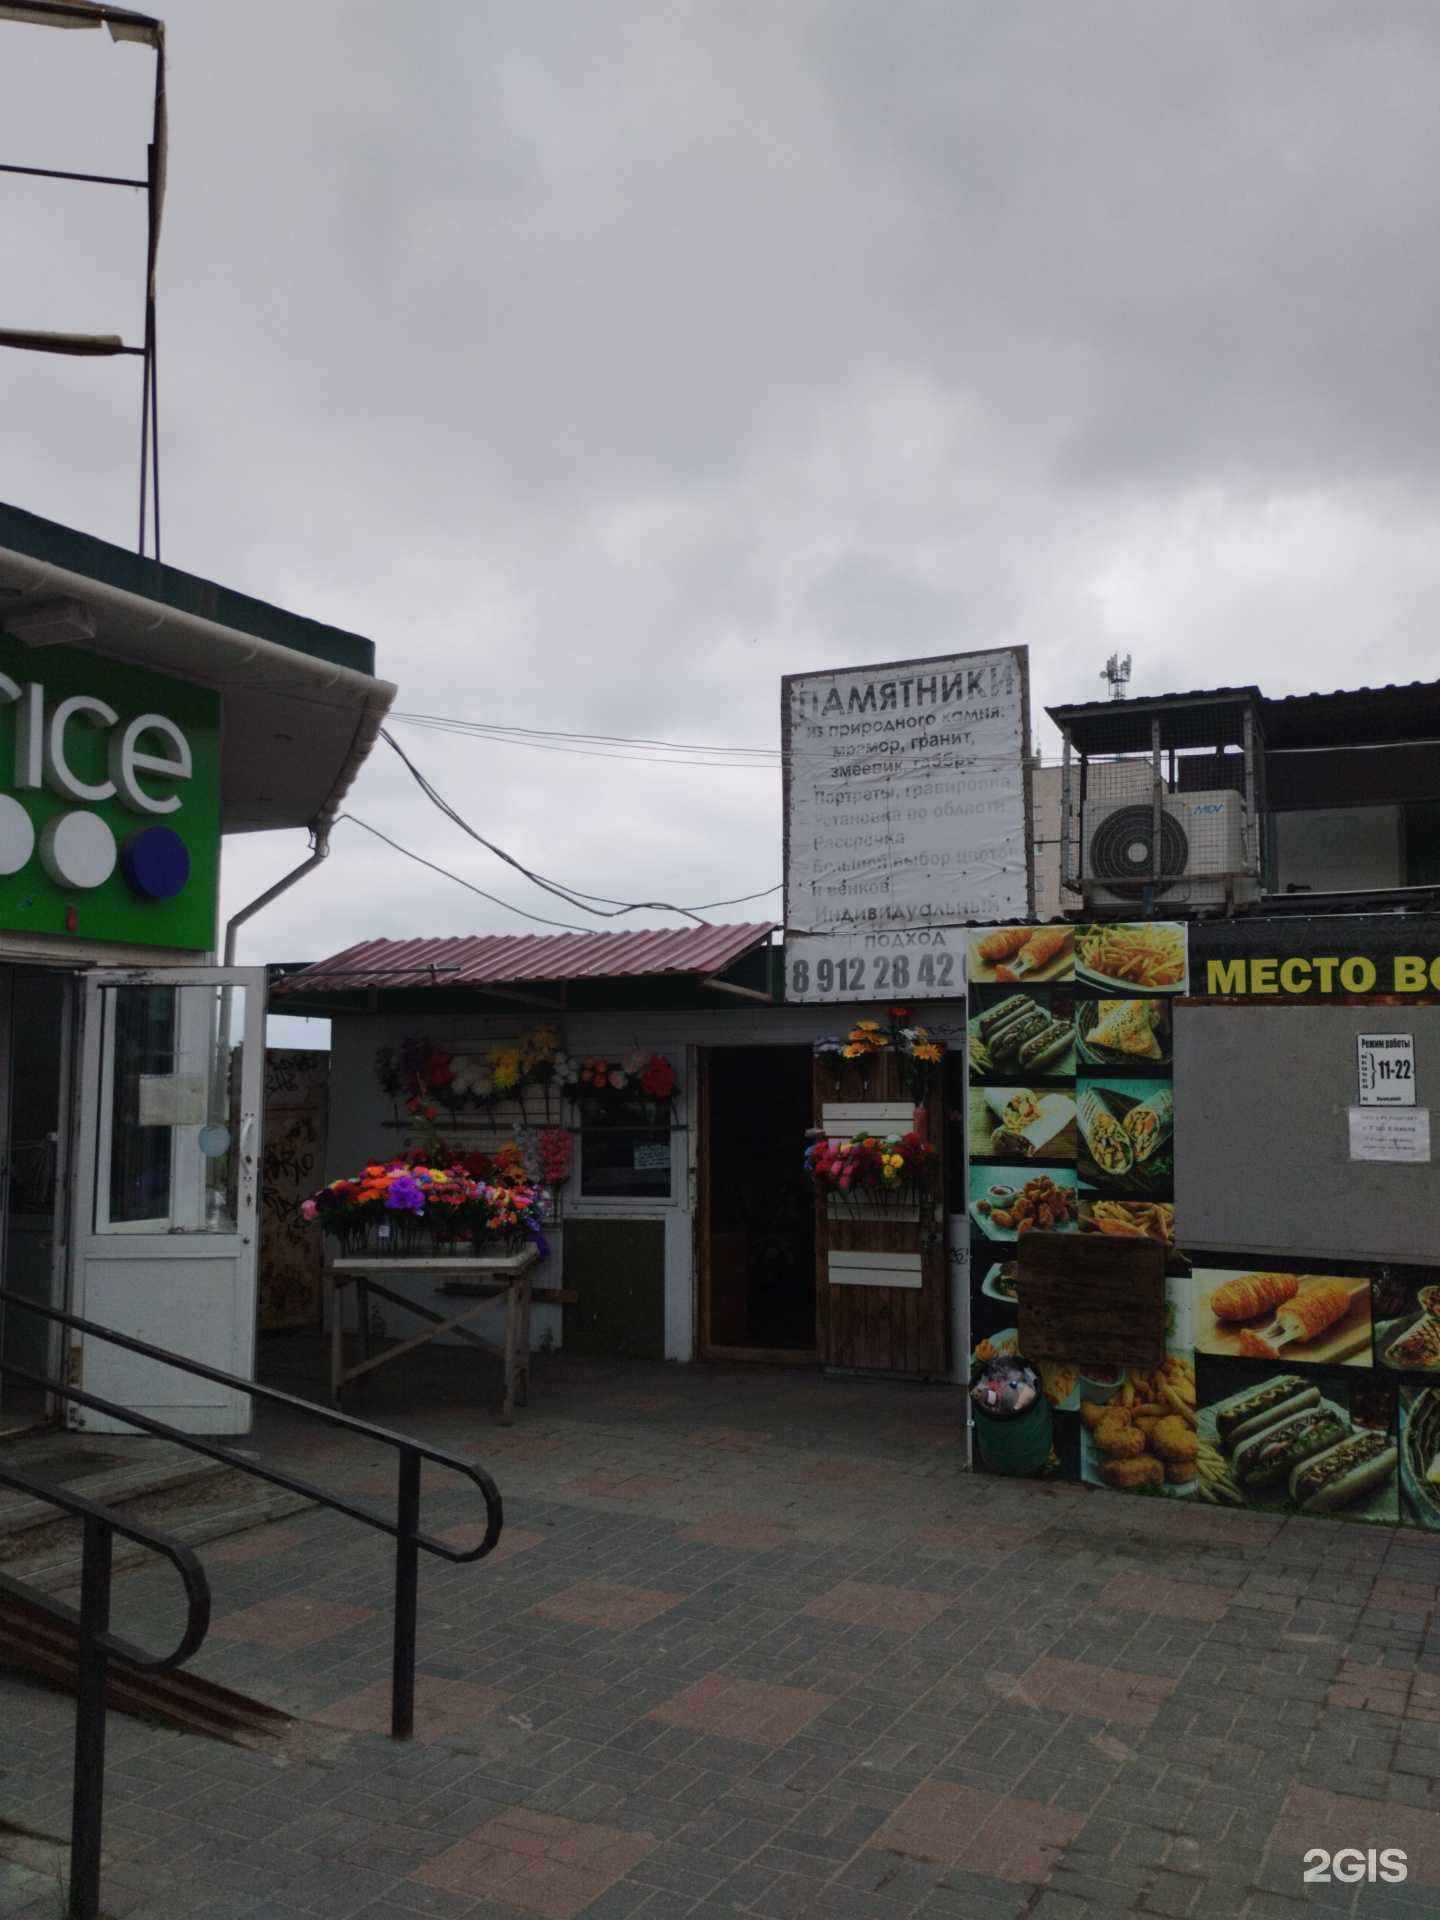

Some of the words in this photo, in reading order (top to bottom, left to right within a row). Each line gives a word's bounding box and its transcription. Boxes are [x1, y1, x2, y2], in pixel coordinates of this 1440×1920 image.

[798, 665, 1014, 718] ПАМЯТНИКИ
[829, 713, 936, 738] природного
[911, 733, 976, 751] гранит,
[792, 959, 810, 992] 8
[816, 957, 866, 992] 912
[872, 955, 910, 989] 28
[917, 952, 954, 988] 42
[1207, 956, 1377, 994] МЕСТО
[1394, 955, 1440, 993] В
[1377, 1058, 1412, 1080] 11-22
